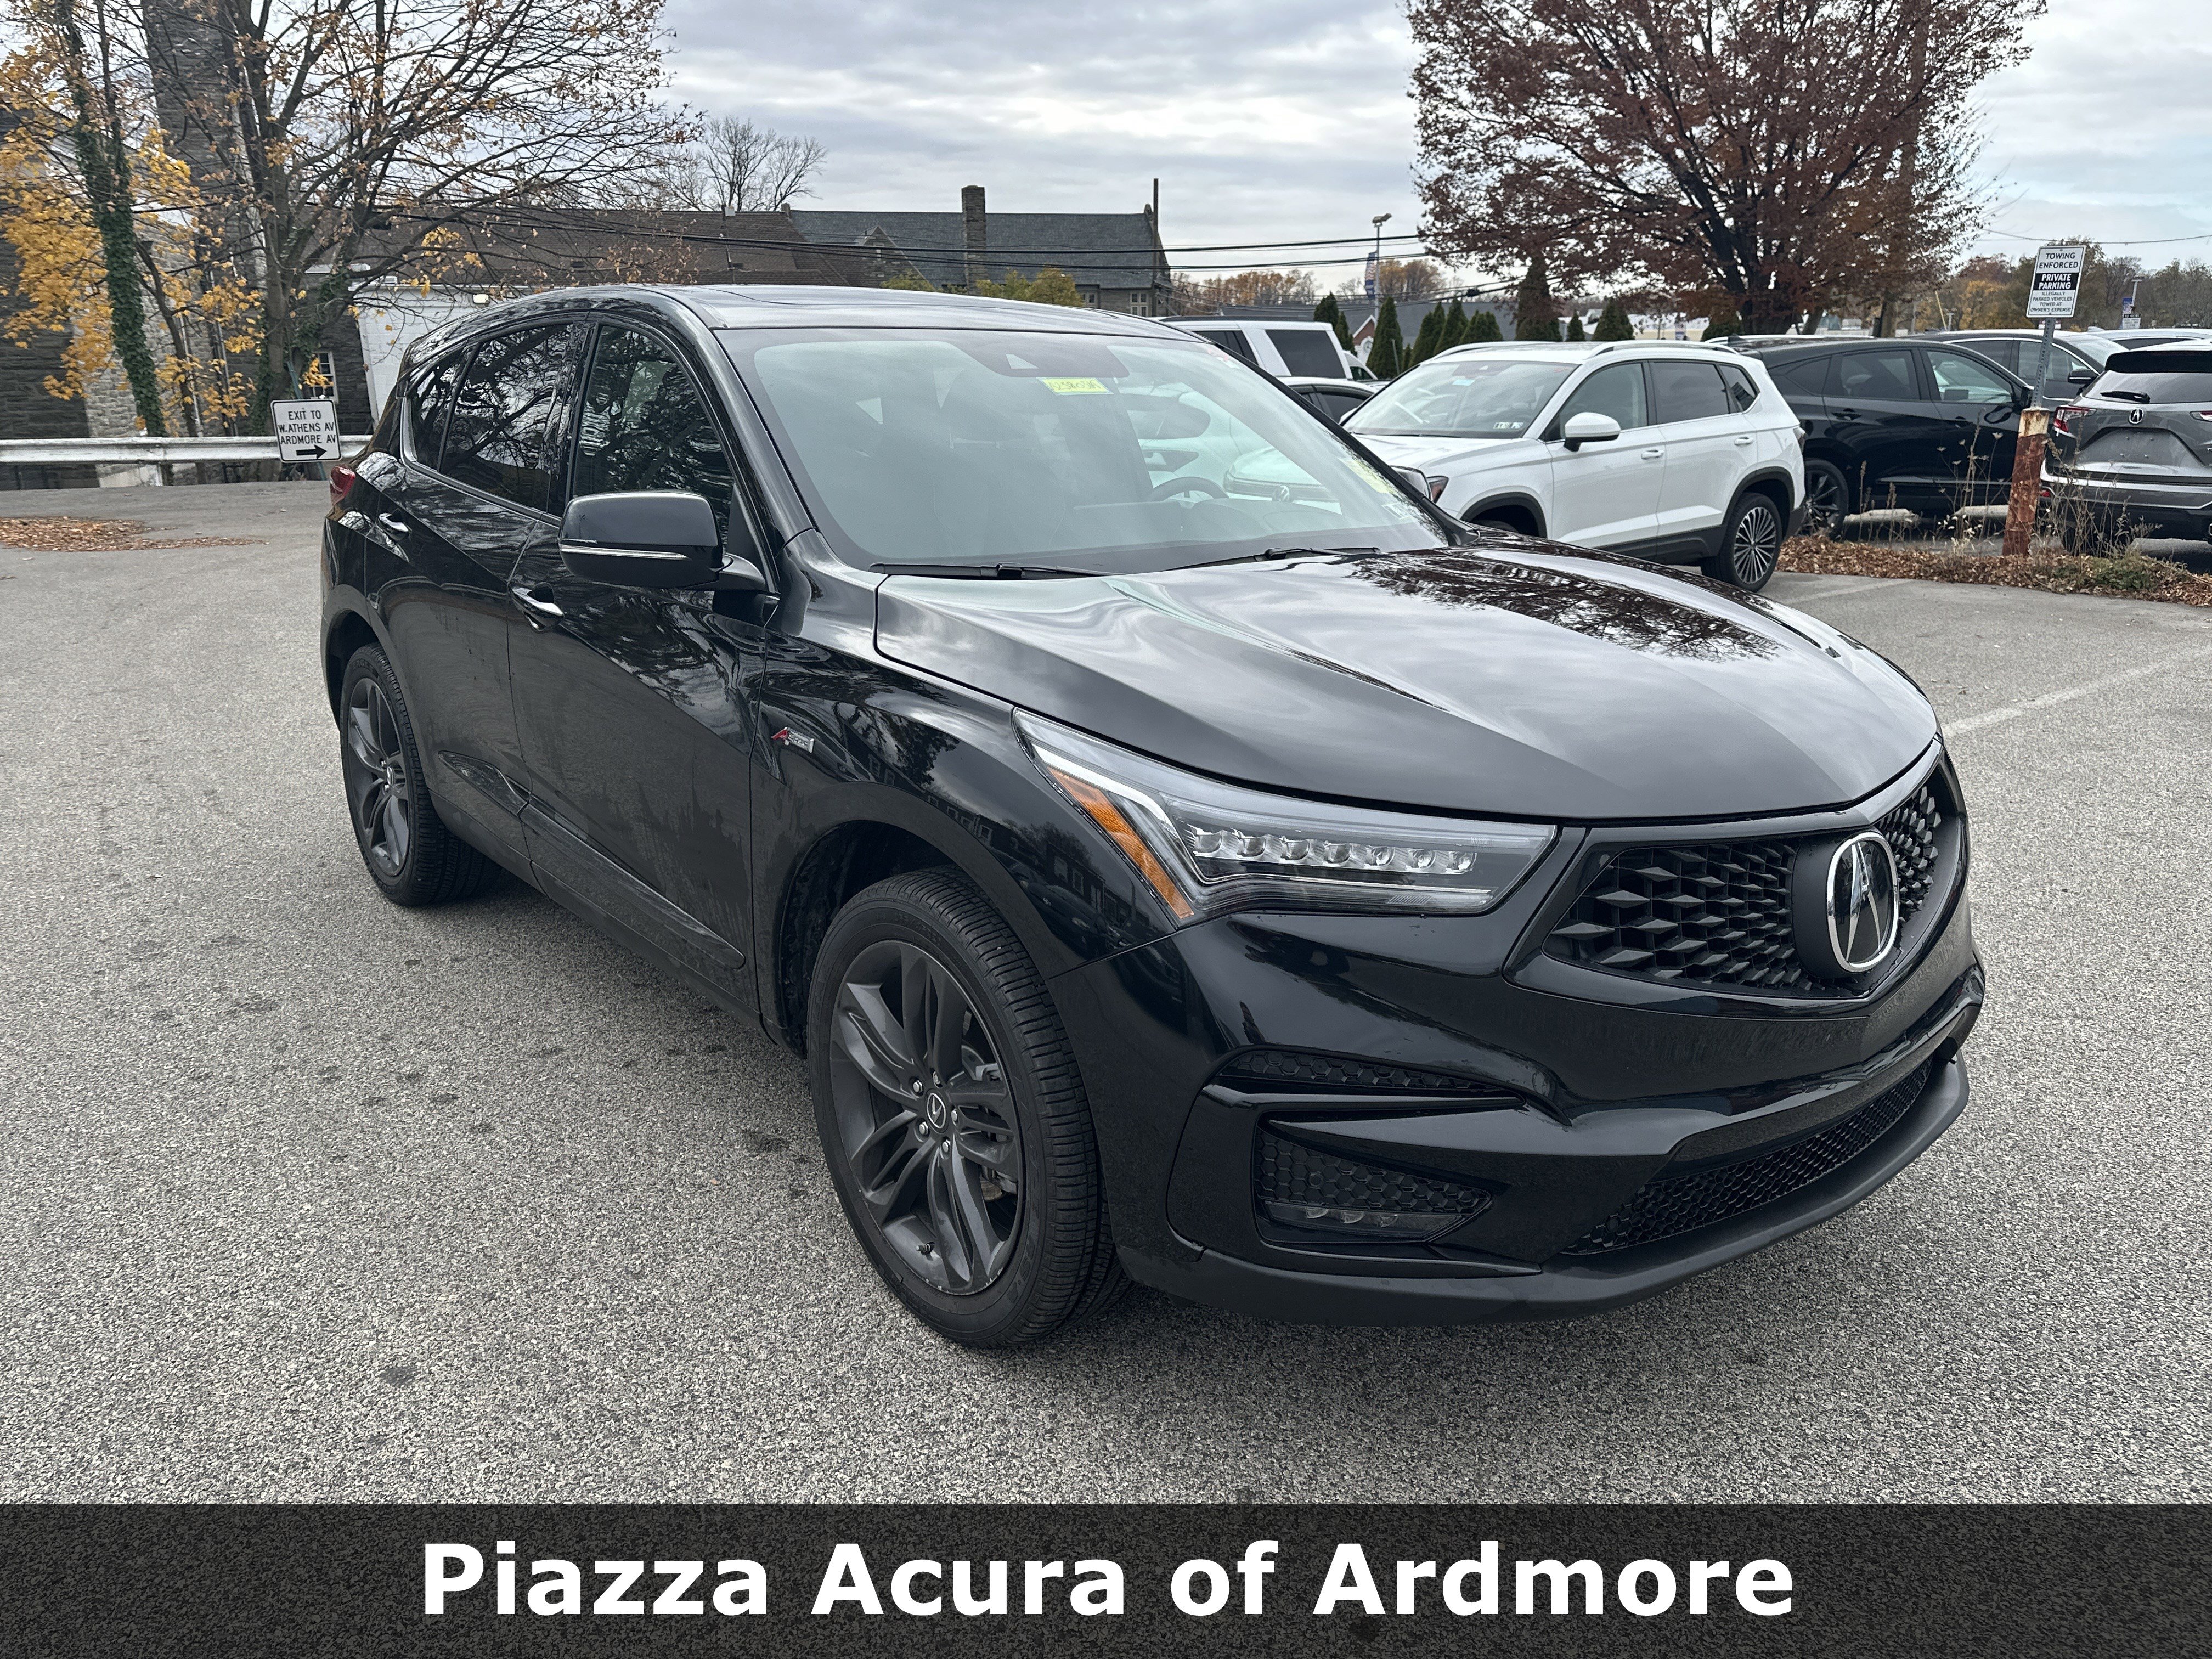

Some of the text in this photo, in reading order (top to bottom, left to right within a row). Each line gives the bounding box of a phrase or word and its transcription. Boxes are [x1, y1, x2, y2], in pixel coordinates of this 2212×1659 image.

[2041, 273, 2072, 281] PRIVATE
[288, 410, 321, 420] EXIT TO
[278, 422, 334, 433] W.ATHENS AV
[280, 435, 336, 445] ARDMORE AV
